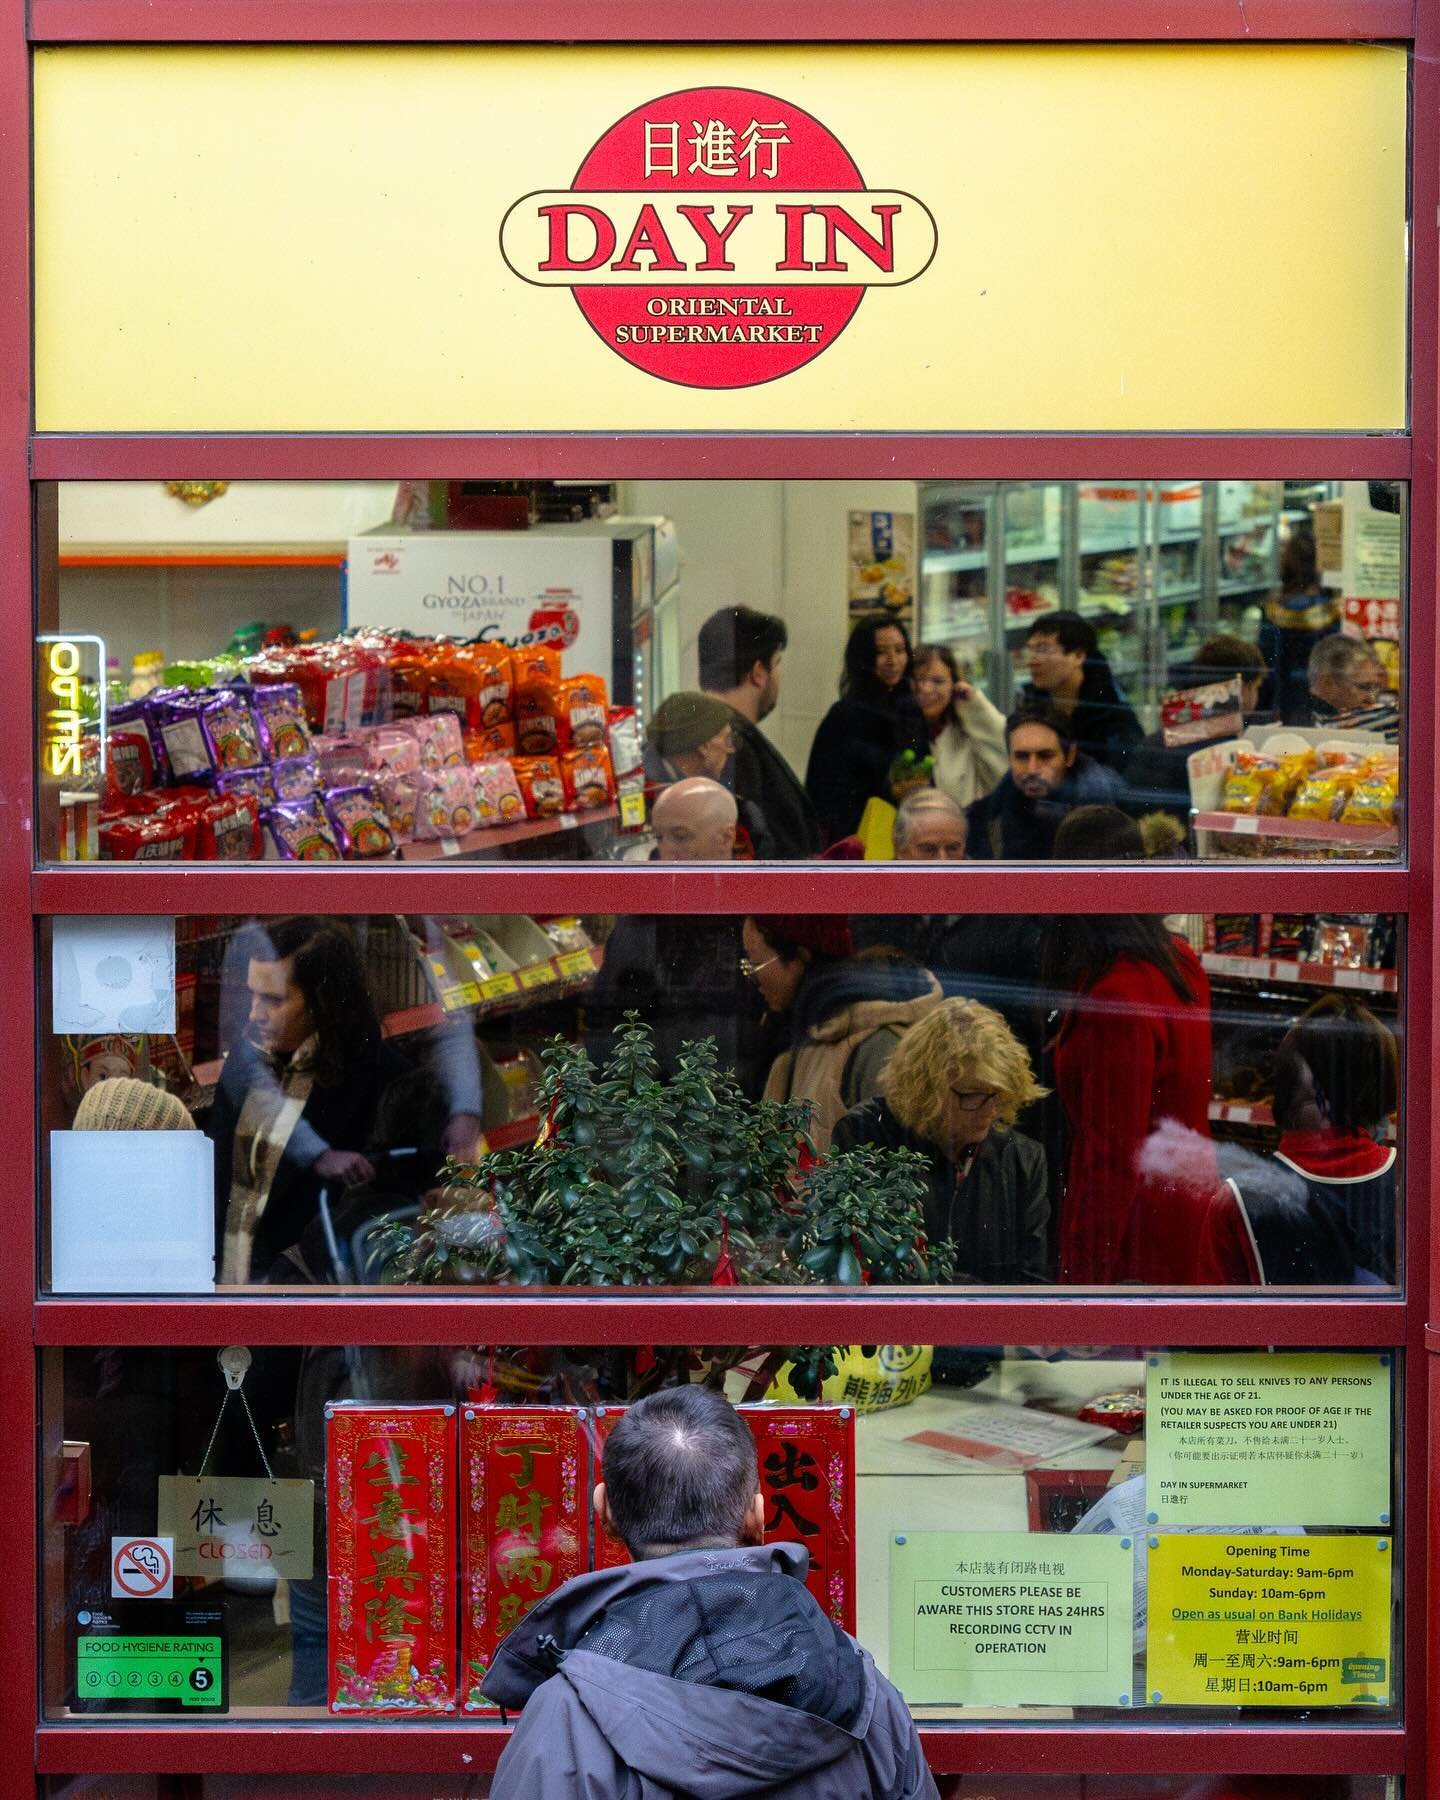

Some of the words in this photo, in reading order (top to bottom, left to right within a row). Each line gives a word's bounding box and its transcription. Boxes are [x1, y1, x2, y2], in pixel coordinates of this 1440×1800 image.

[643, 118, 792, 180] 日進行
[537, 203, 753, 272] DAY
[775, 203, 902, 273] IN
[646, 297, 793, 317] ORIENTAL
[615, 325, 824, 344] SUPERMARKET
[1160, 1378, 1169, 1386] IT
[1172, 1378, 1180, 1386] IS
[1183, 1378, 1218, 1386] ILLEGAL
[1221, 1378, 1233, 1386] TO
[1236, 1378, 1256, 1386] SELL
[1259, 1377, 1291, 1386] KNIVES
[1294, 1377, 1306, 1386] TO
[1309, 1377, 1328, 1385] ANY
[1331, 1377, 1372, 1386] PERSONS
[1161, 1392, 1192, 1400] UNDER
[1194, 1392, 1212, 1400] THE
[1214, 1392, 1232, 1400] AGE
[1234, 1391, 1246, 1400] OF
[1248, 1391, 1261, 1400] 21.
[1160, 1407, 1183, 1417] (YOU
[1186, 1408, 1207, 1416] MAY
[1210, 1408, 1221, 1416] BE
[1223, 1407, 1253, 1416] ASKED
[1255, 1407, 1273, 1416] FOR
[1275, 1407, 1306, 1416] PROOF
[1309, 1406, 1321, 1415] OF
[1323, 1407, 1342, 1415] AGE
[1344, 1407, 1352, 1415] IF
[1355, 1407, 1372, 1416] THE
[1160, 1421, 1201, 1429] RETAILER
[1203, 1421, 1247, 1430] SUSPECTS
[1249, 1421, 1268, 1430] YOU
[1270, 1421, 1288, 1429] ARE
[1290, 1420, 1321, 1429] UNDER
[1323, 1420, 1337, 1430] 21)
[1160, 1481, 1177, 1489] DAY
[1178, 1481, 1188, 1489] IN
[1189, 1481, 1248, 1489] SUPERMARKET
[763, 1441, 823, 1572] 出入
[199, 1542, 273, 1560] CLOSED
[1226, 1545, 1277, 1559] Opening
[1280, 1545, 1310, 1557] Time
[956, 1561, 1065, 1576] 本店装有闭路电视
[1181, 1566, 1294, 1578] Monday-Saturday:
[1296, 1567, 1354, 1579] 9am-6pm
[941, 1585, 1016, 1597] CUSTOMERS
[1020, 1585, 1063, 1598] PLEASE
[1066, 1587, 1081, 1598] BE
[1209, 1587, 1258, 1600] Sunday:
[1261, 1588, 1326, 1600] 10am-6pm
[917, 1604, 963, 1616] AWARE
[967, 1605, 993, 1616] THIS
[996, 1605, 1035, 1616] STORE
[1038, 1606, 1063, 1617] HAS
[1066, 1606, 1105, 1617] 24HRS
[1171, 1607, 1204, 1620] Open
[1208, 1611, 1221, 1619] as
[1224, 1609, 1256, 1619] usual
[1259, 1612, 1273, 1620] on
[1278, 1609, 1309, 1620] Bank
[1312, 1609, 1363, 1622] Holidays
[949, 1623, 1022, 1635] RECORDING
[1025, 1624, 1056, 1635] CCTV
[1059, 1625, 1072, 1636] IN
[1235, 1629, 1299, 1645] 营业时间
[86, 1643, 119, 1652] FOOD
[123, 1643, 172, 1652] HYGIENE
[173, 1643, 214, 1652] RATING
[975, 1642, 1047, 1654] OPERATION
[195, 1670, 208, 1689] 5
